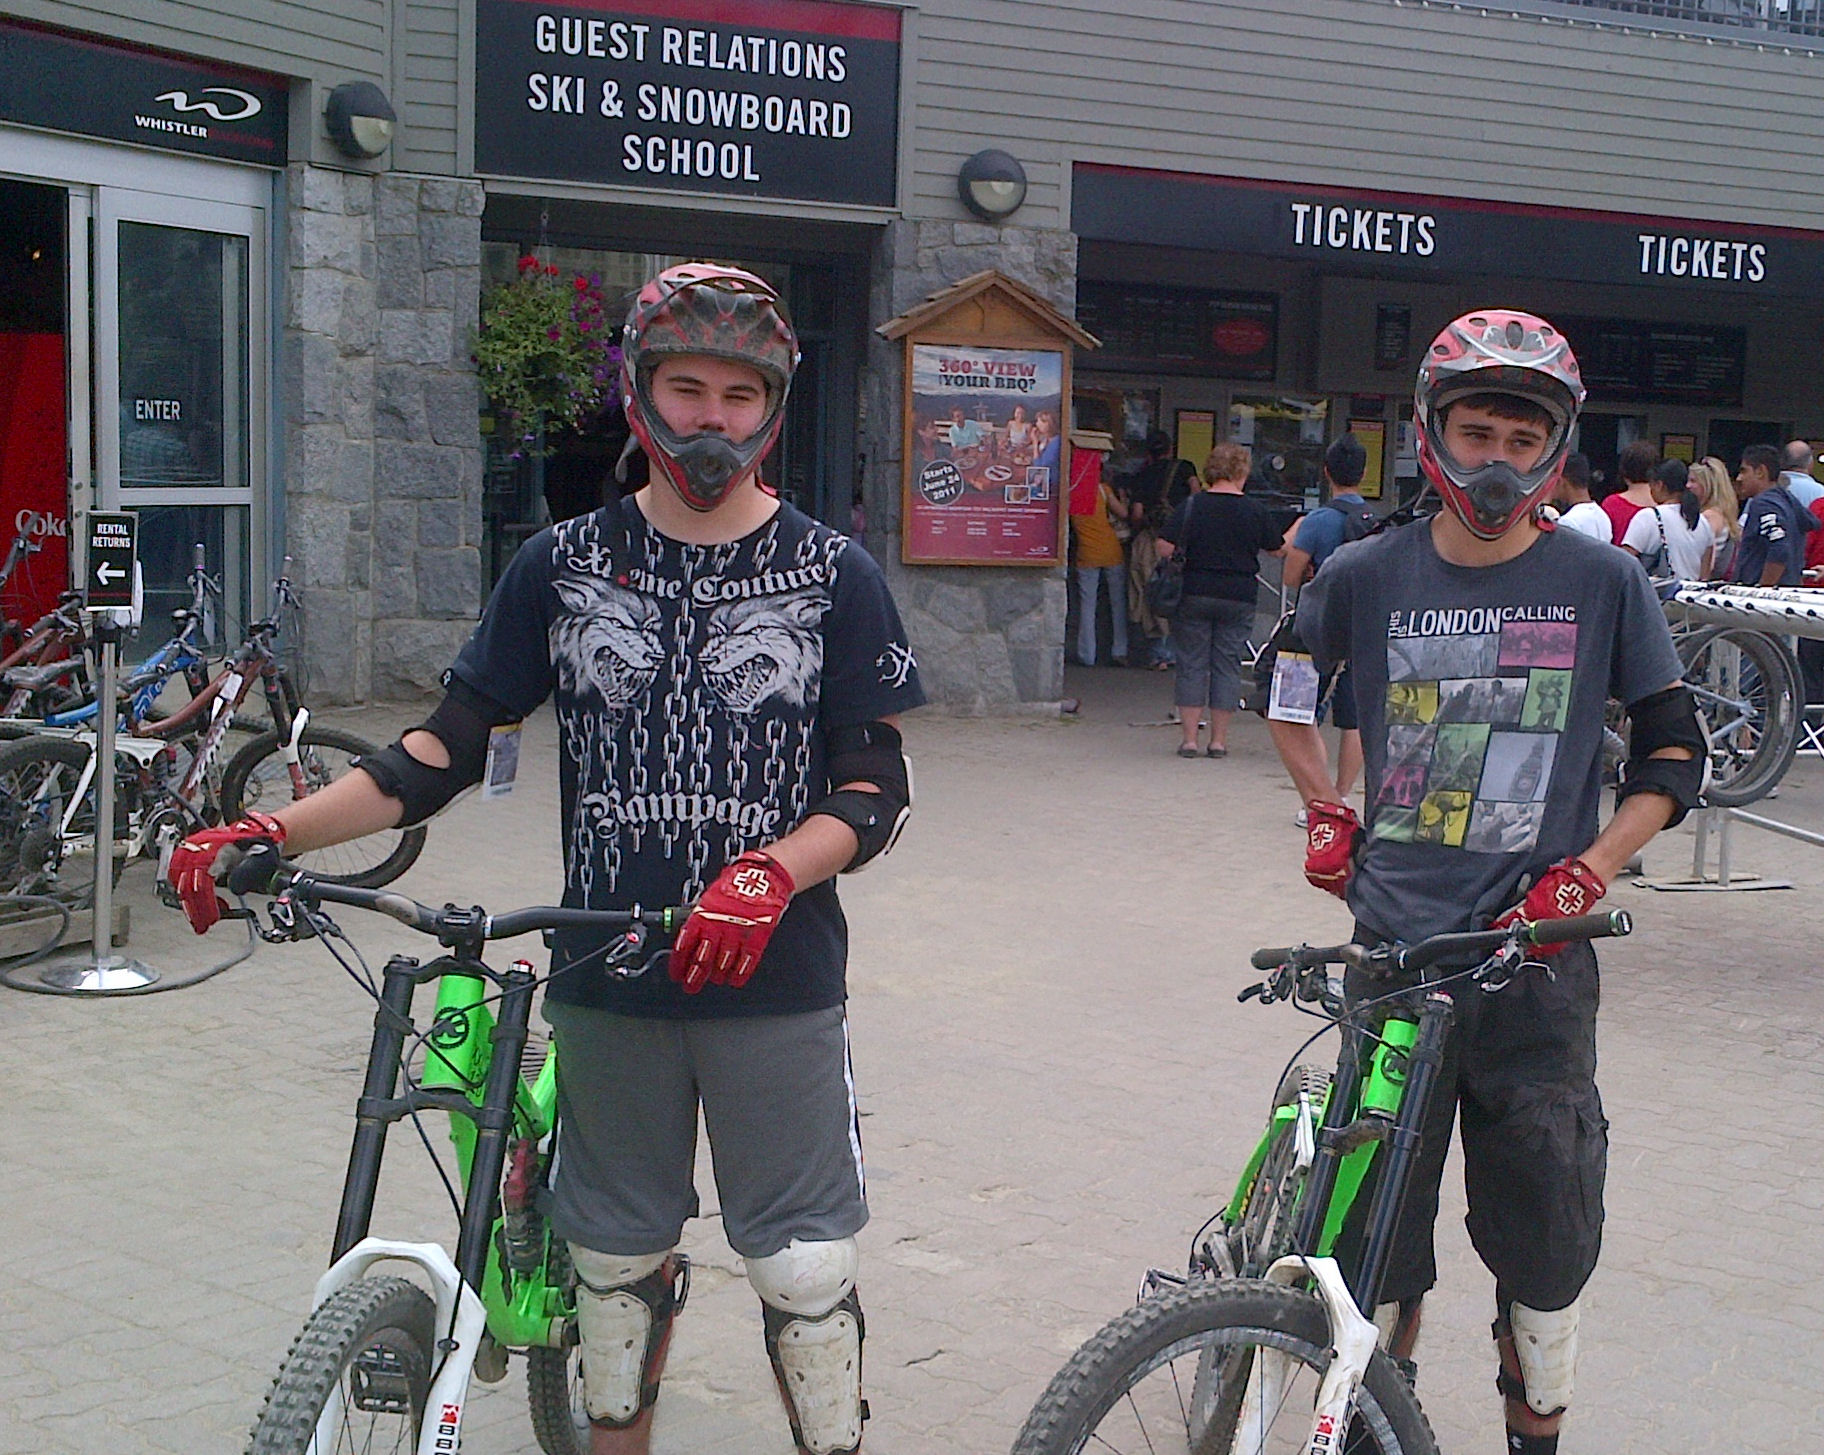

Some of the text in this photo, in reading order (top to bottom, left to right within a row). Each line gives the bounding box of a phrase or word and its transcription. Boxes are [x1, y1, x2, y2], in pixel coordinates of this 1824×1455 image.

[535, 14, 847, 83] GUEST RELATIONS
[527, 73, 851, 139] SKI & SNOWBOARD
[134, 114, 208, 139] WHISTLER
[622, 134, 760, 182] SCHOOL
[1291, 202, 1437, 257] TICKETS
[1637, 234, 1767, 283] TICKETS
[983, 361, 1037, 377] VIEW
[942, 374, 990, 388] YOUR
[994, 376, 1037, 393] BBQ?
[135, 399, 181, 421] ENTER
[933, 486, 956, 500] 2011
[92, 536, 131, 548] RETURNS
[96, 523, 129, 536] RENTAL
[692, 562, 826, 609] Couture
[1387, 610, 1401, 638] THIS
[1398, 625, 1408, 638] IS
[1407, 605, 1577, 637] LONDON CALLING
[583, 787, 781, 839] Rampage
